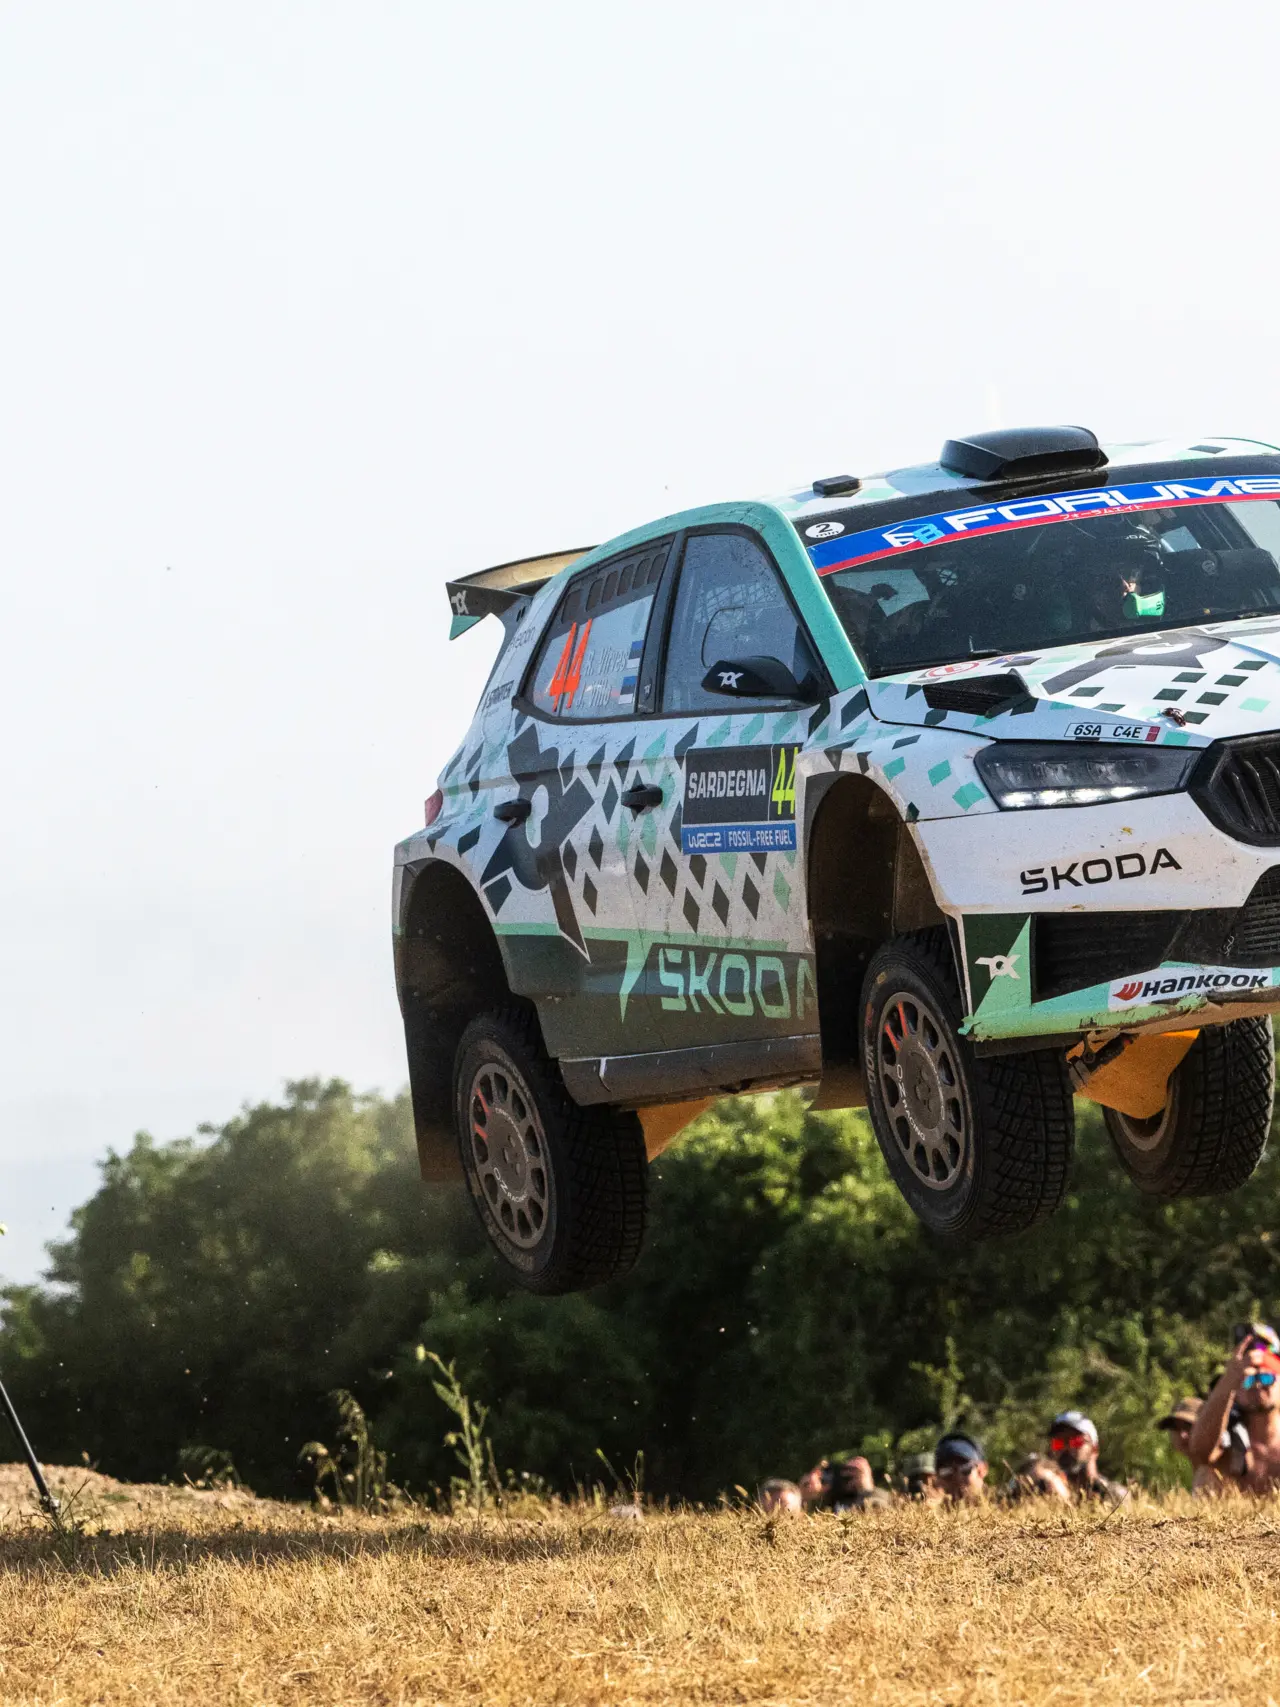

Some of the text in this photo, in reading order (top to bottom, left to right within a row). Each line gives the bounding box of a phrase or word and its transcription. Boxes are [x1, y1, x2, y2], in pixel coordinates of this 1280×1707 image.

[816, 523, 833, 534] 2
[549, 618, 593, 712] 44
[1073, 724, 1143, 739] 6SA C4E
[688, 769, 766, 799] SARDEGNA
[772, 746, 799, 815] 44
[728, 829, 793, 847] FOSSIL-FREE FUEL
[1019, 847, 1183, 895] SKODA
